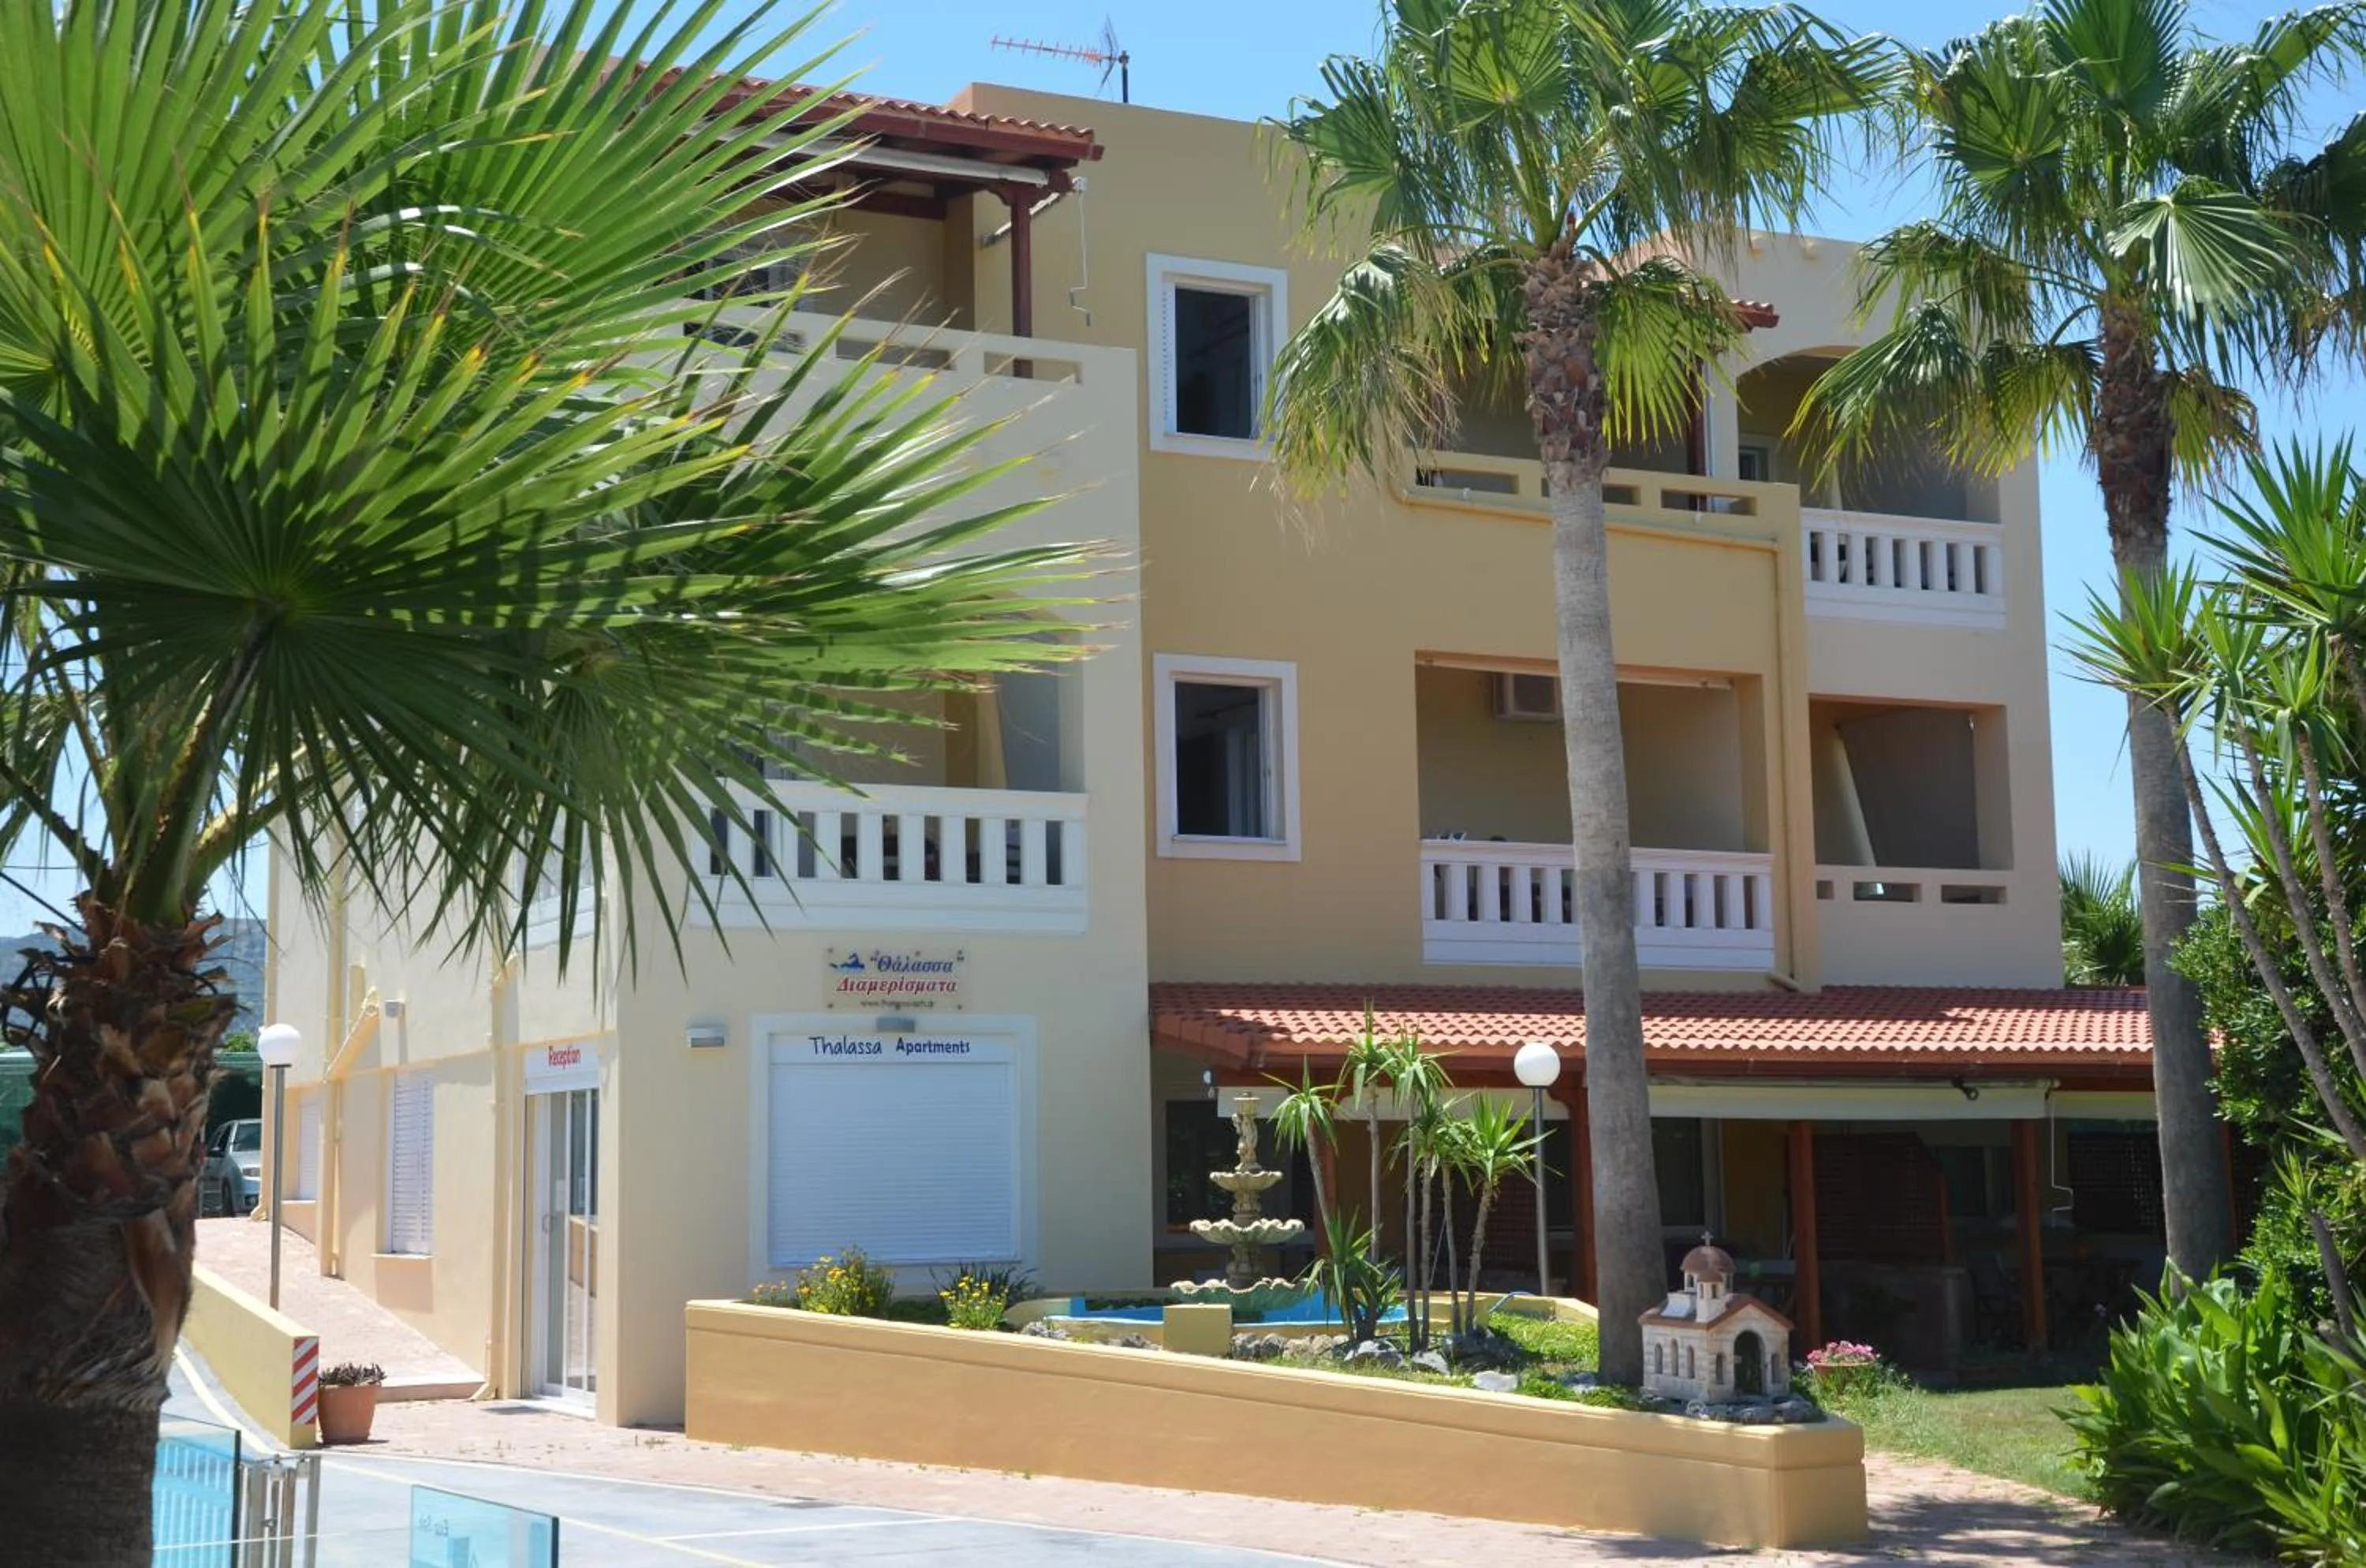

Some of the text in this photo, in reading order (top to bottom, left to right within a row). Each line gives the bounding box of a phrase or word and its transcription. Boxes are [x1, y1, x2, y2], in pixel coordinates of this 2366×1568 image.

[836, 976, 957, 995] Διαμερίσματα
[808, 1035, 971, 1057] Thalassa Apartments
[548, 1046, 580, 1070] Reception
